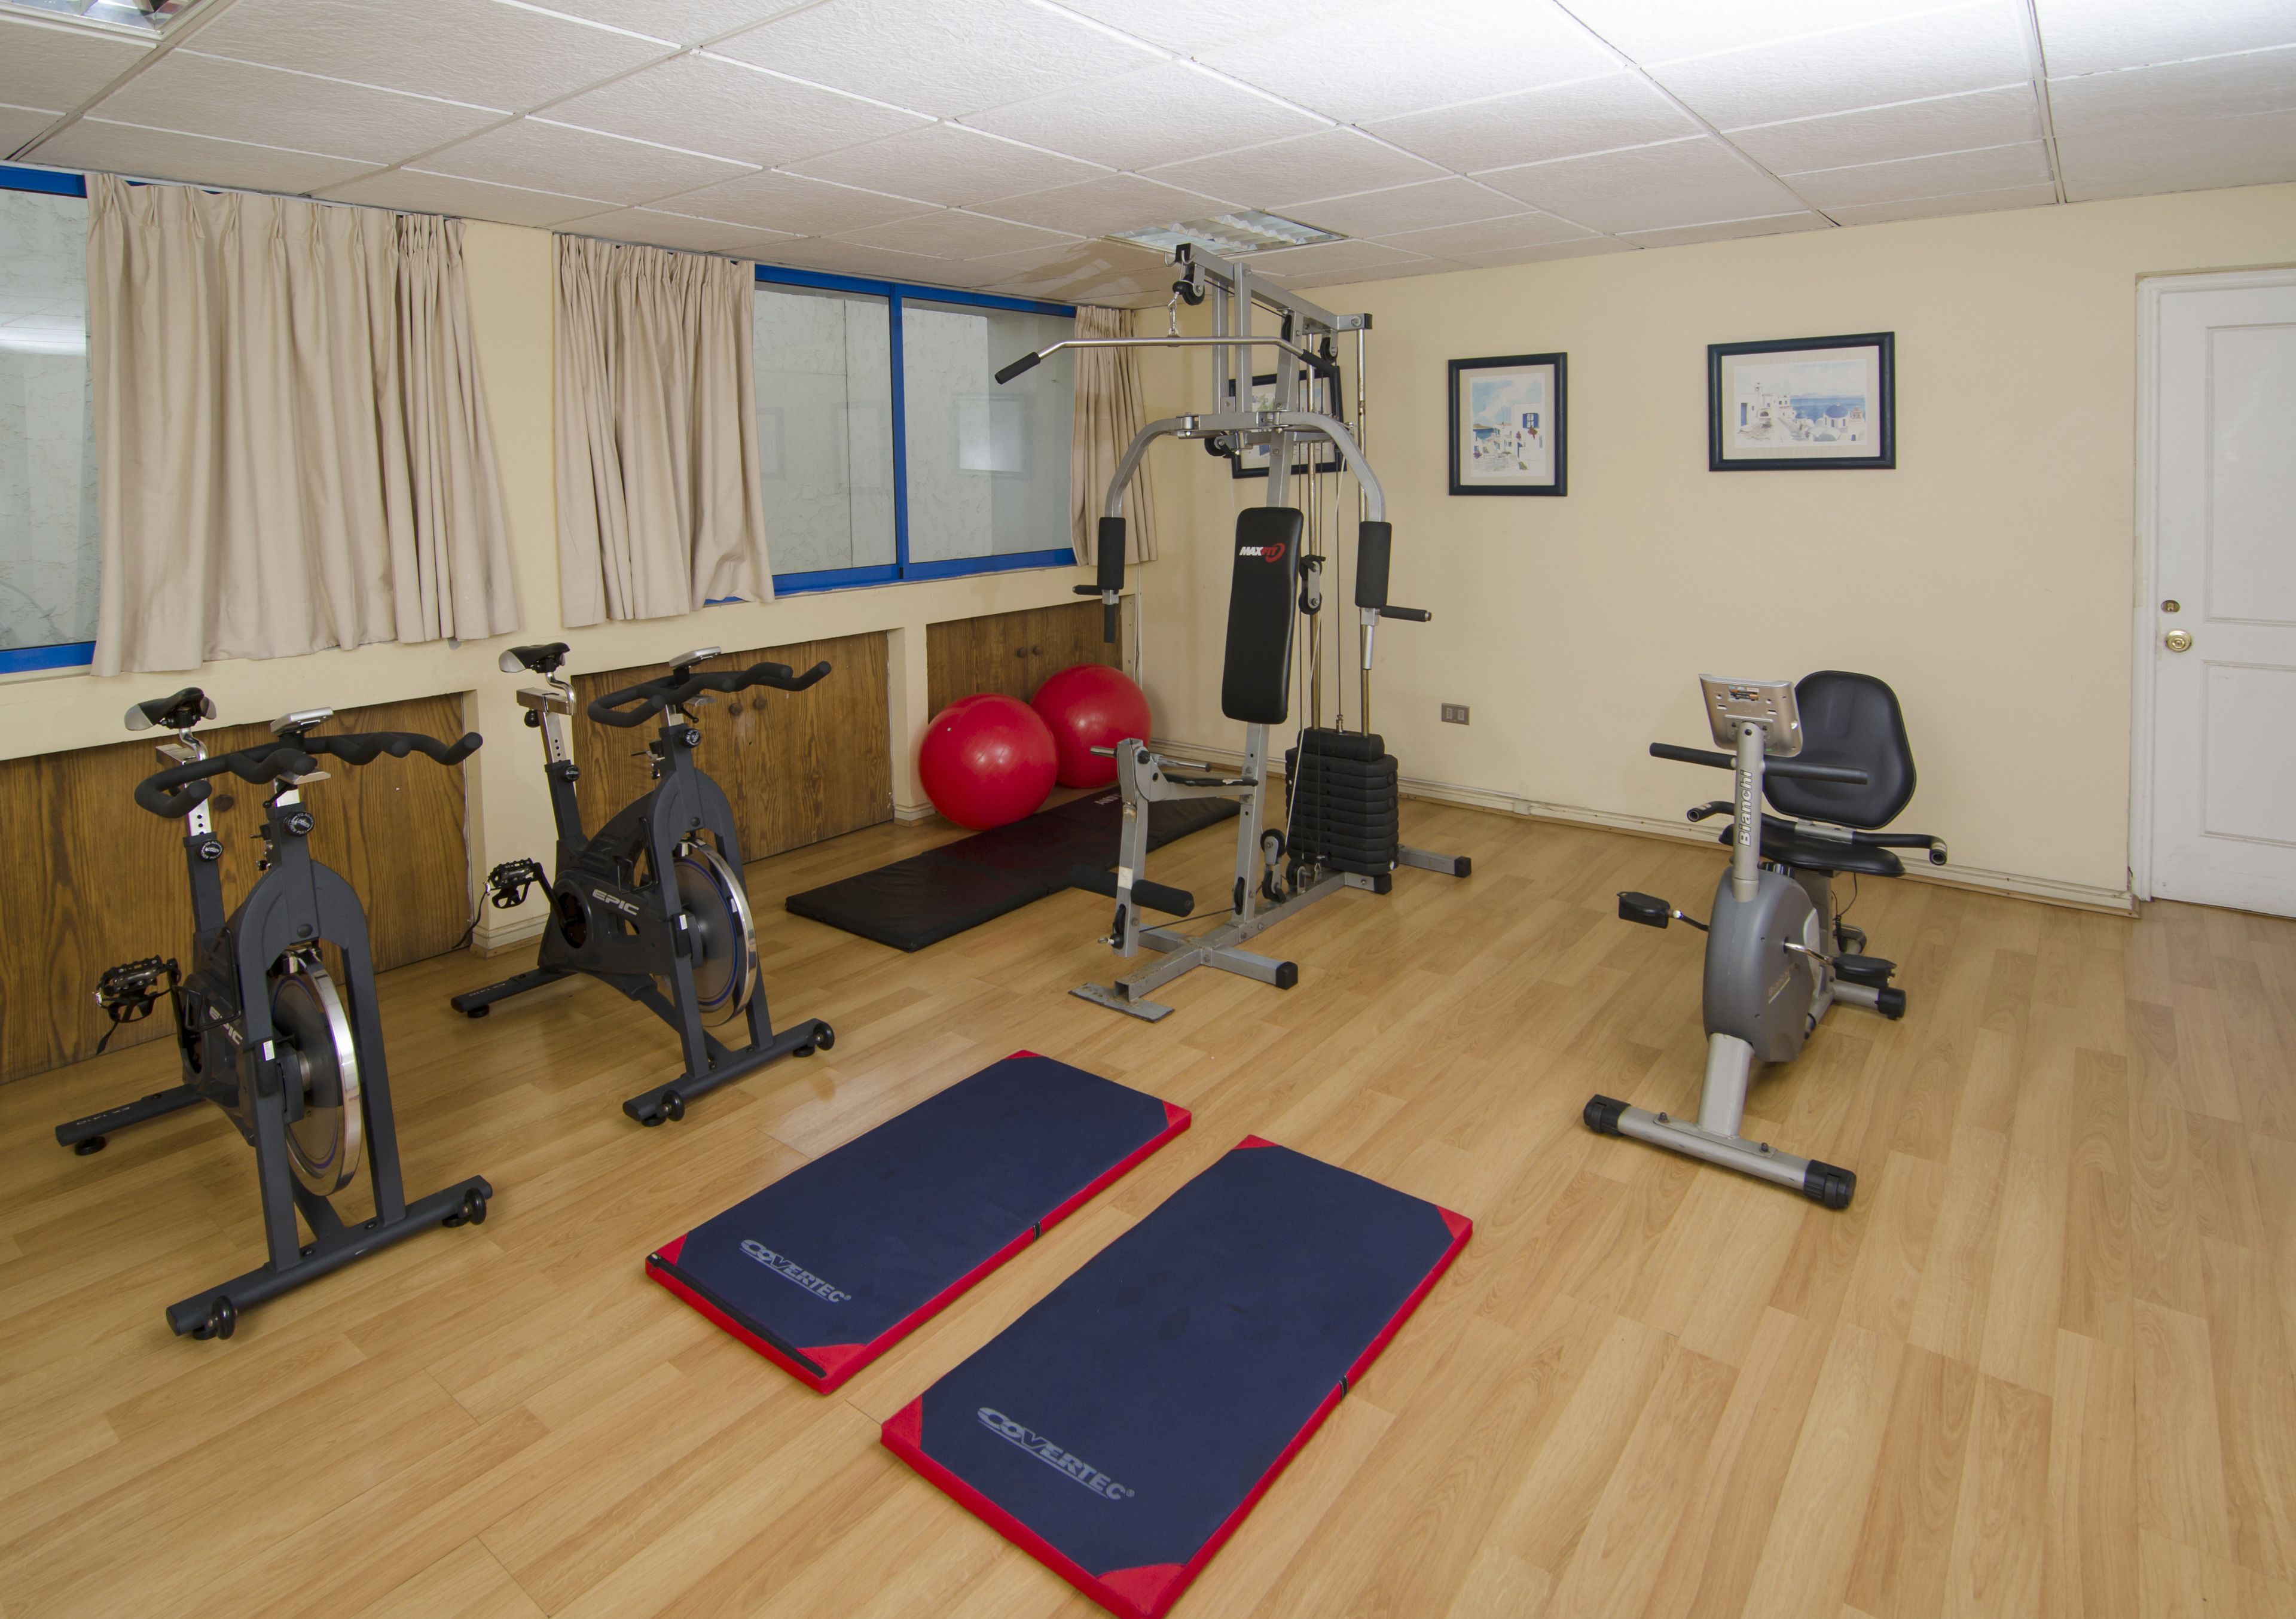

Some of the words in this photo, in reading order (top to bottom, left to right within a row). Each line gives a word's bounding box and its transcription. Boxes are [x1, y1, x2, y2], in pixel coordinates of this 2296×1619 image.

[1239, 546, 1278, 556] MAXFIT
[1738, 769, 1752, 847] Bianchi
[593, 889, 640, 916] EPIC
